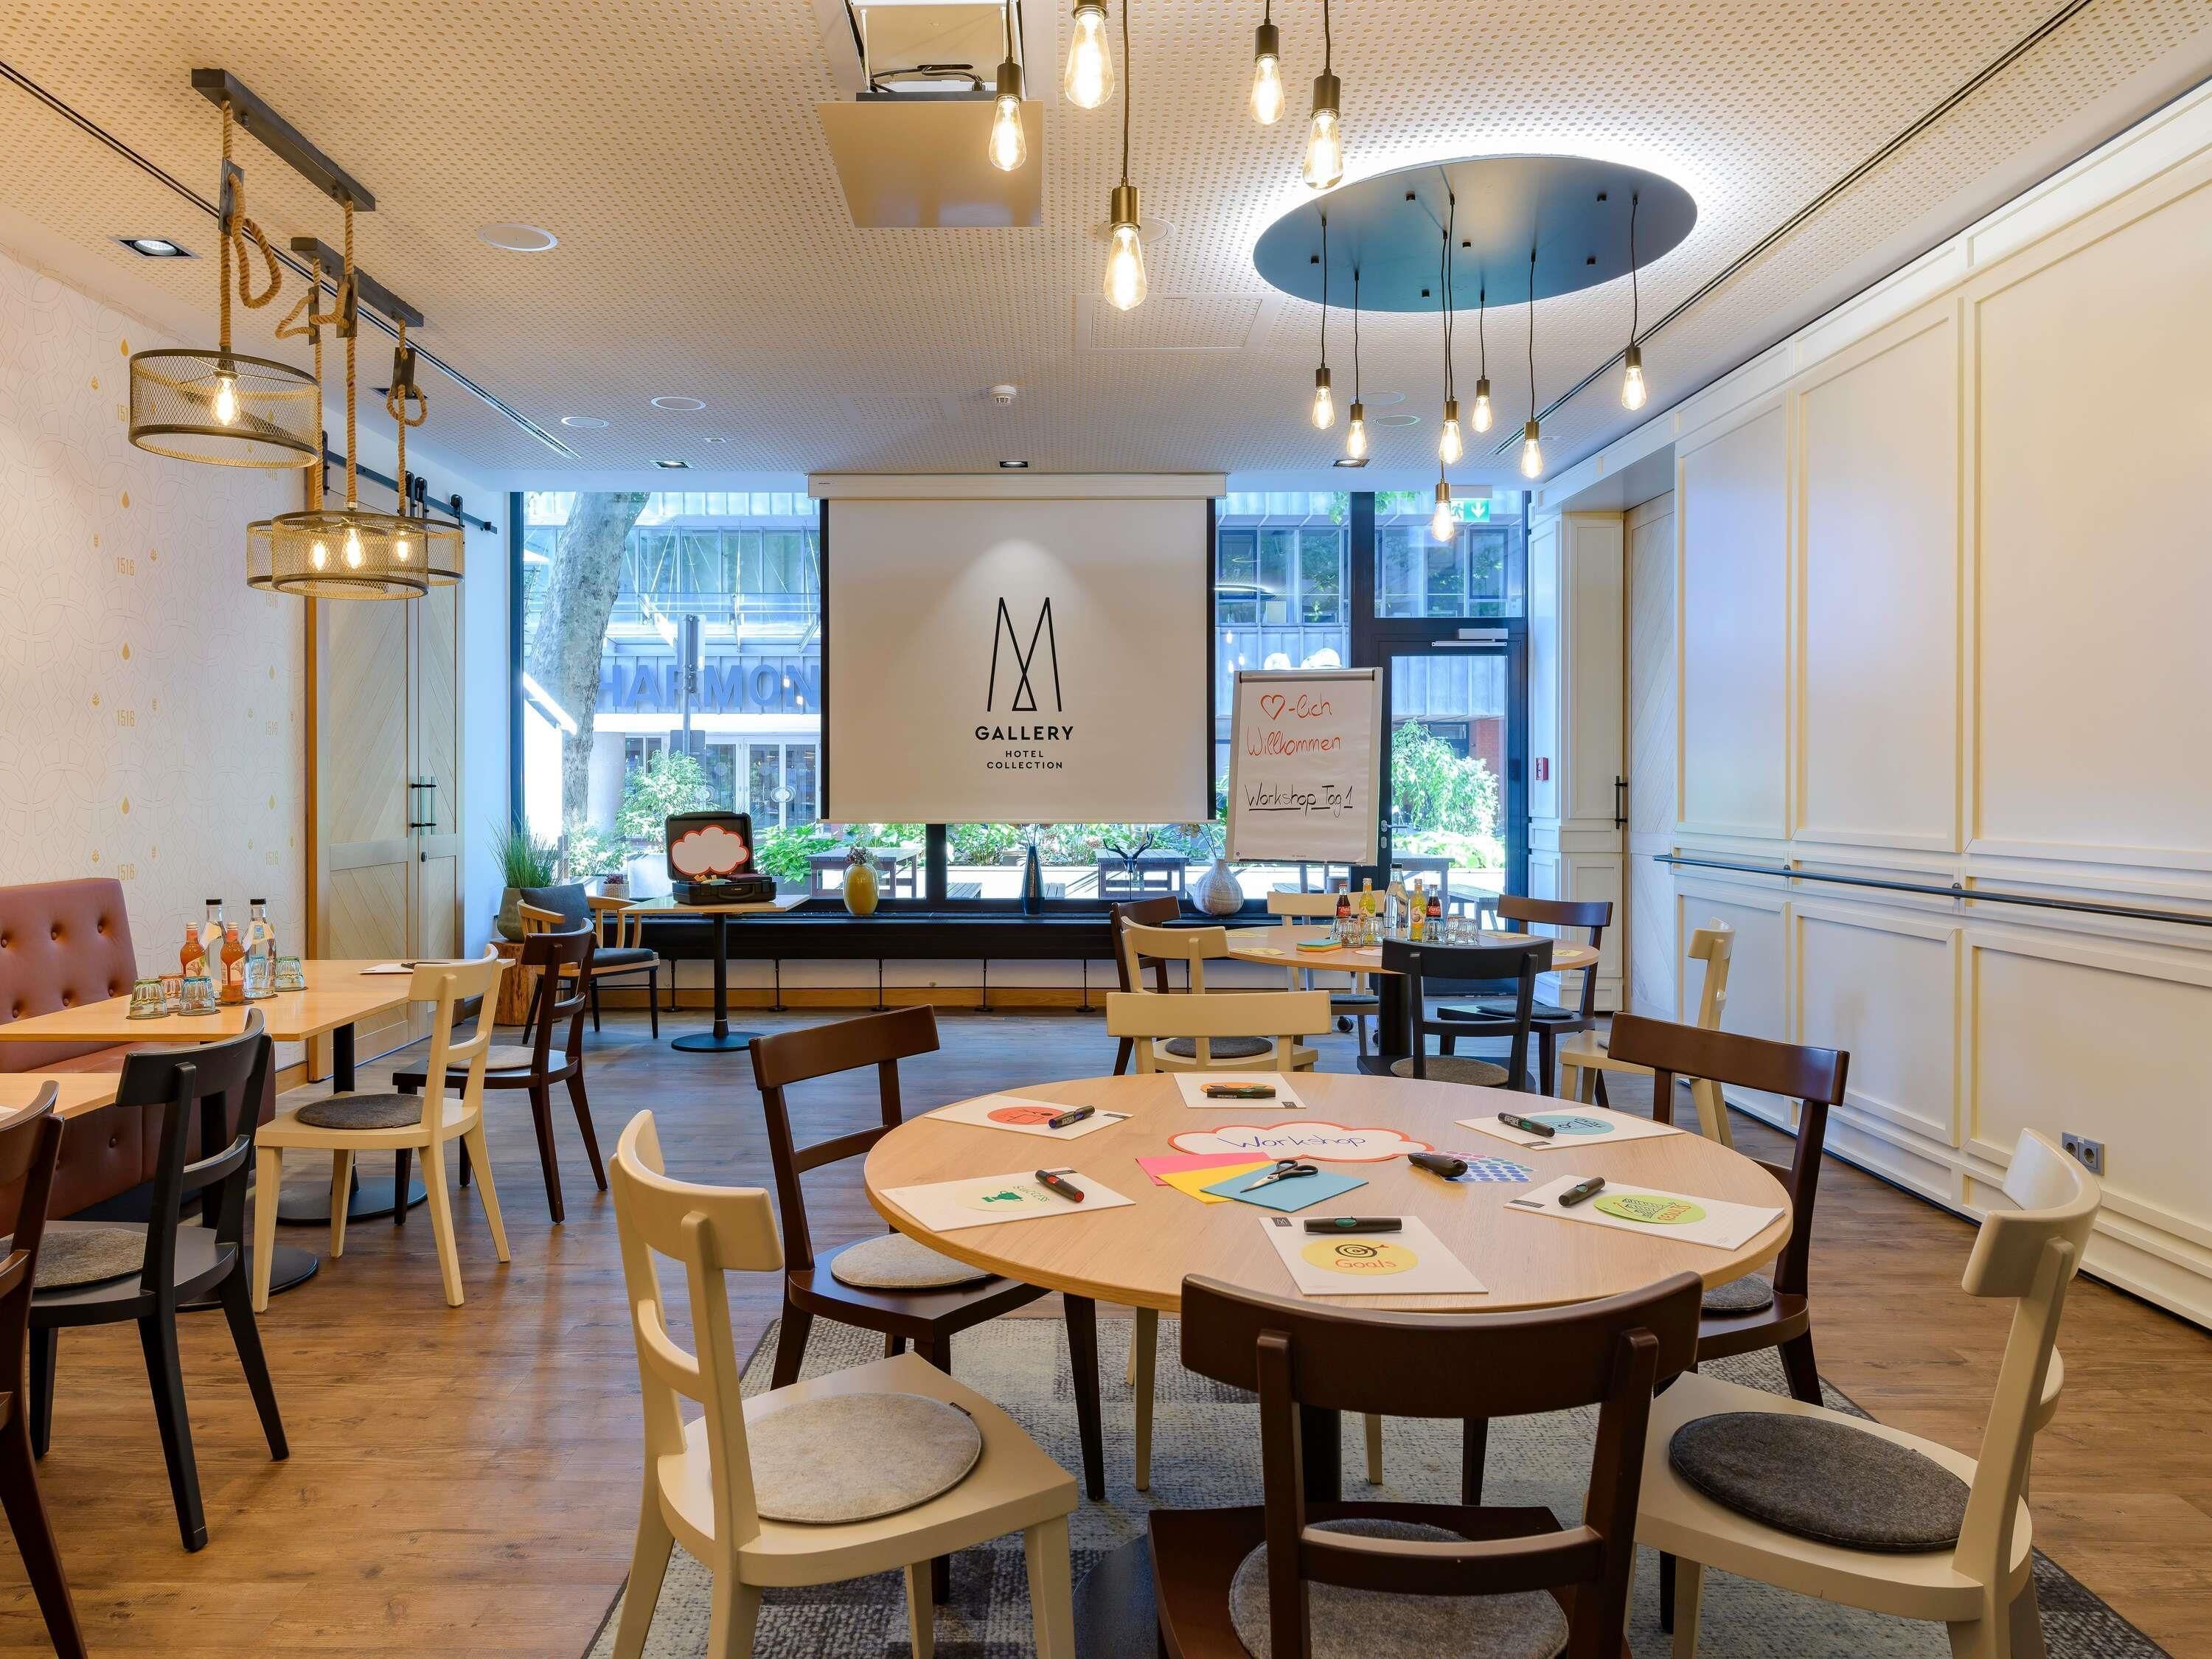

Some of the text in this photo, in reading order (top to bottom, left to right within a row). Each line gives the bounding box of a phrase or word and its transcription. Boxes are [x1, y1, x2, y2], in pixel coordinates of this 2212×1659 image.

[117, 404, 129, 422] 151
[117, 557, 134, 576] 1516
[117, 709, 134, 726] 1516
[975, 726, 1074, 741] GALLERY
[1247, 726, 1341, 756] Willkommen
[1005, 750, 1044, 758] HOTEL
[987, 761, 1063, 769] COLLECTION
[1245, 782, 1353, 818] Workshop Tag 1
[117, 863, 135, 880] 1516
[1217, 1134, 1366, 1147] Workshop
[1335, 1259, 1398, 1269] Goals
